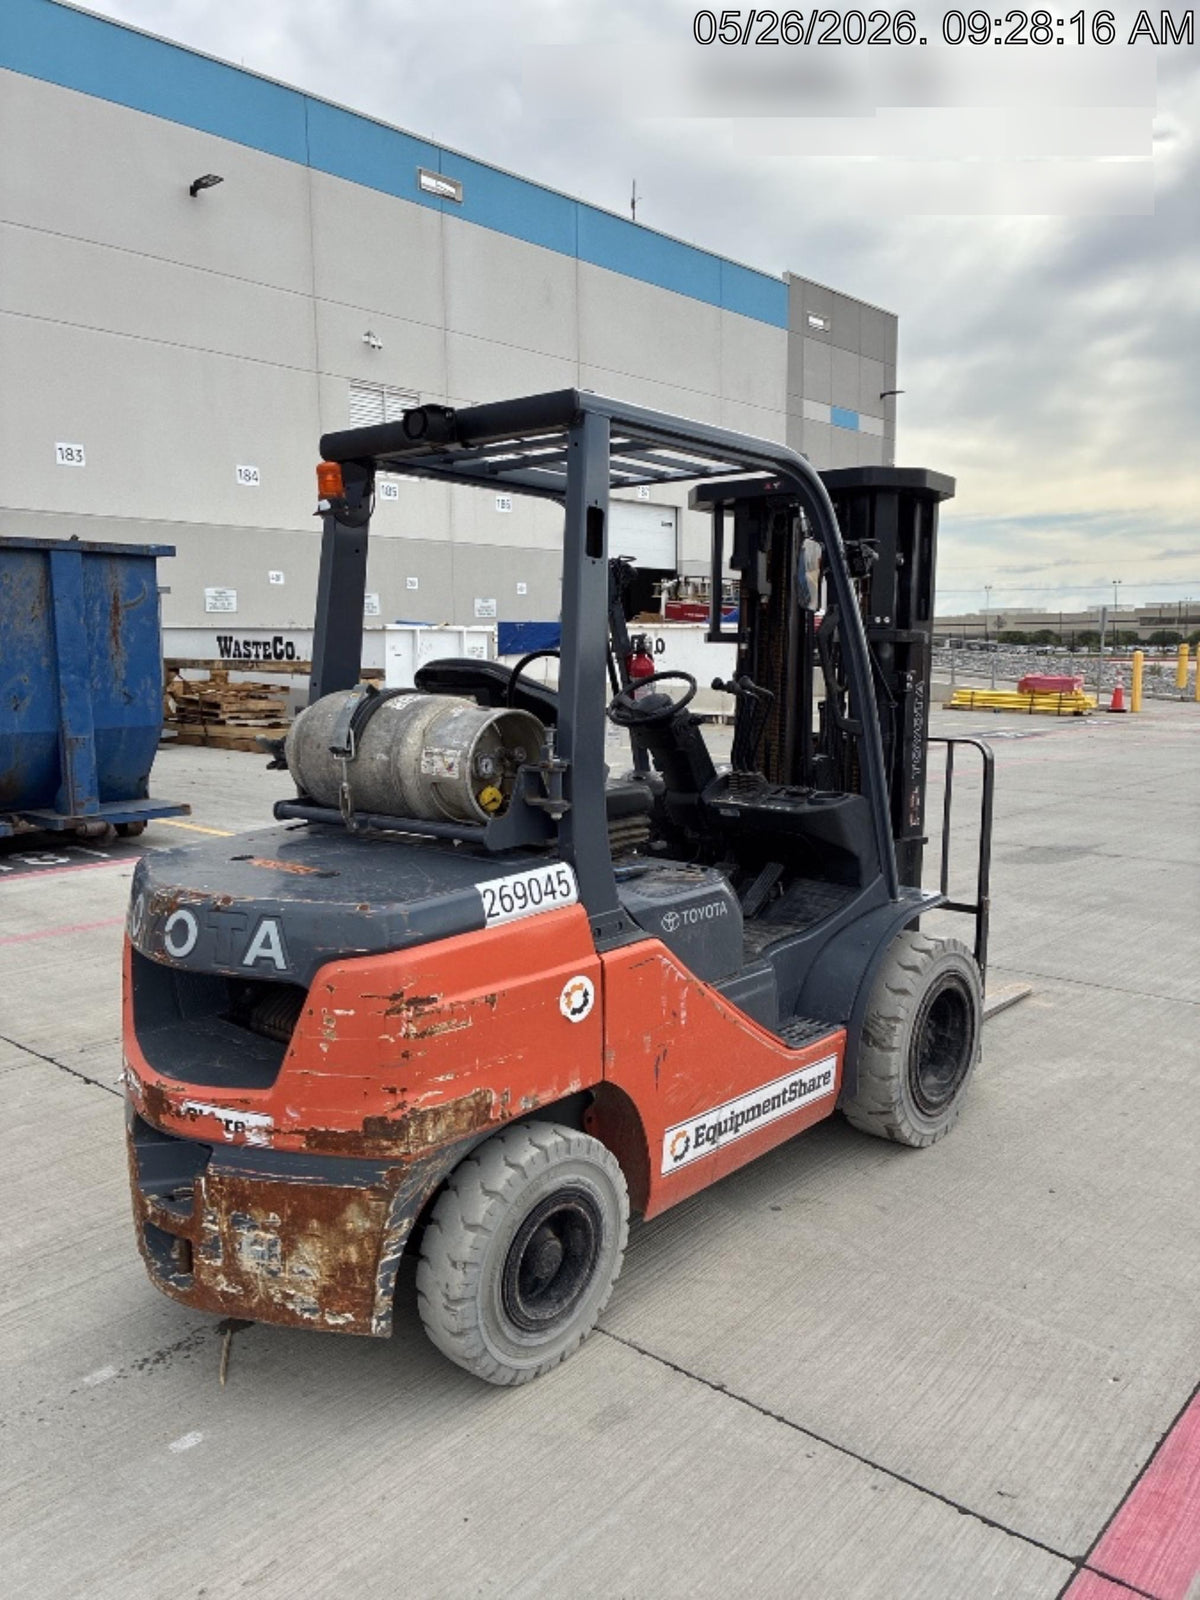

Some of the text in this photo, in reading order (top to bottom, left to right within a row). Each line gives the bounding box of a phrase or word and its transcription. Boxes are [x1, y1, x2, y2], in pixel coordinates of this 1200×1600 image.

[57, 447, 84, 463] 183
[238, 468, 259, 482] 184
[482, 869, 571, 918] 269045
[681, 900, 728, 925] TOYOTA
[692, 1068, 832, 1149] EquipmentShare
